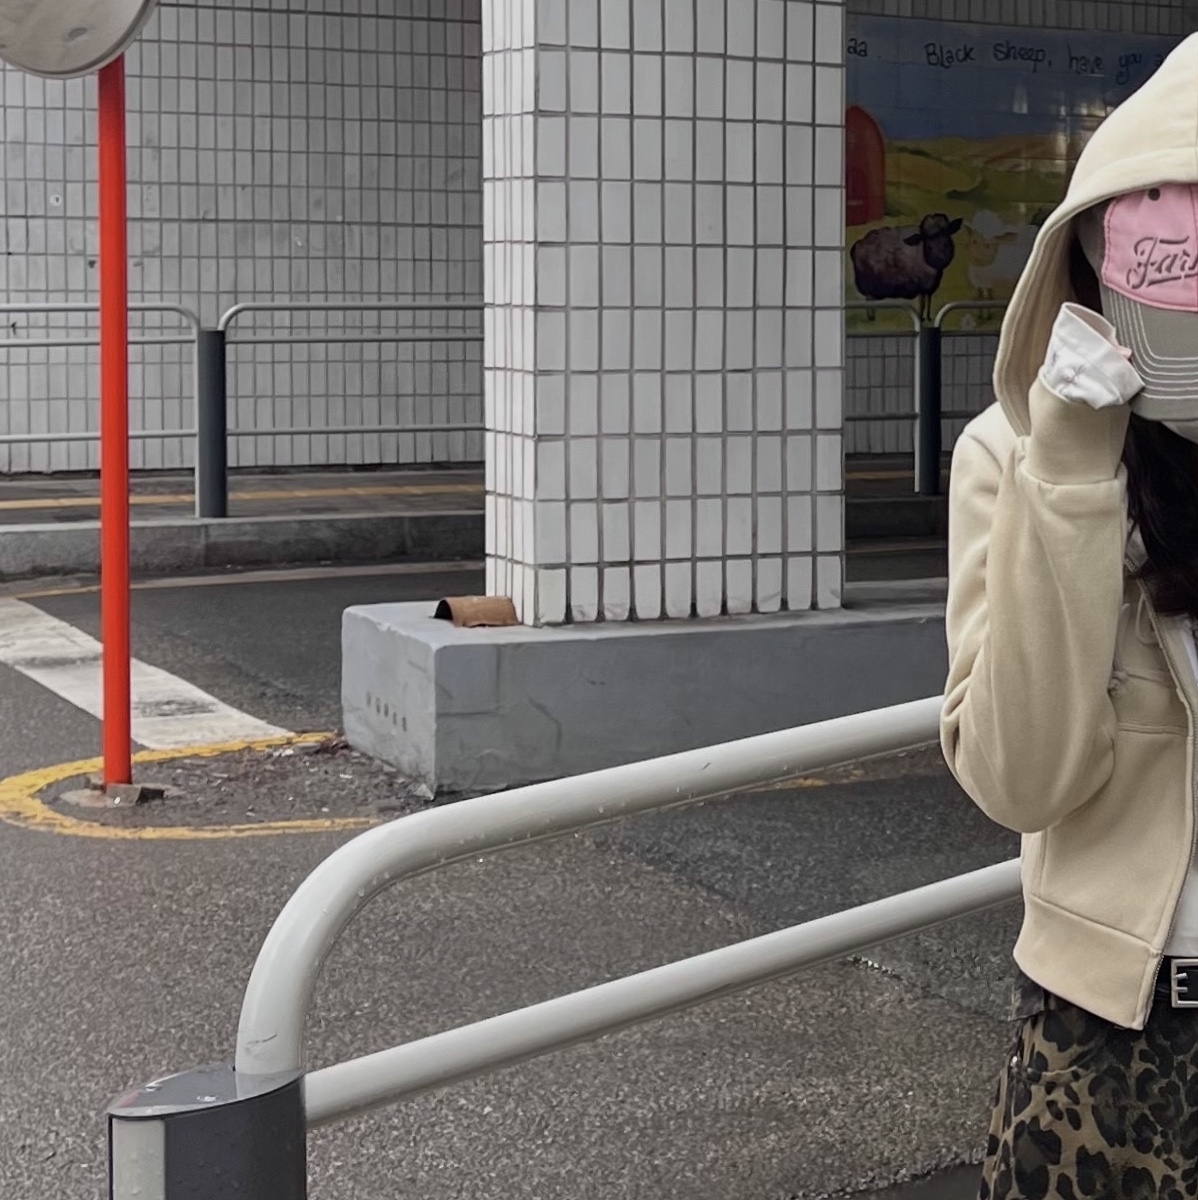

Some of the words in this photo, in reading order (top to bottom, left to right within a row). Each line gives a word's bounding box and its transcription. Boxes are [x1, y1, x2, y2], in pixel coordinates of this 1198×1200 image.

[846, 37, 868, 57] aa
[924, 42, 976, 69] Black
[1067, 44, 1105, 75] have
[1115, 53, 1142, 85] you
